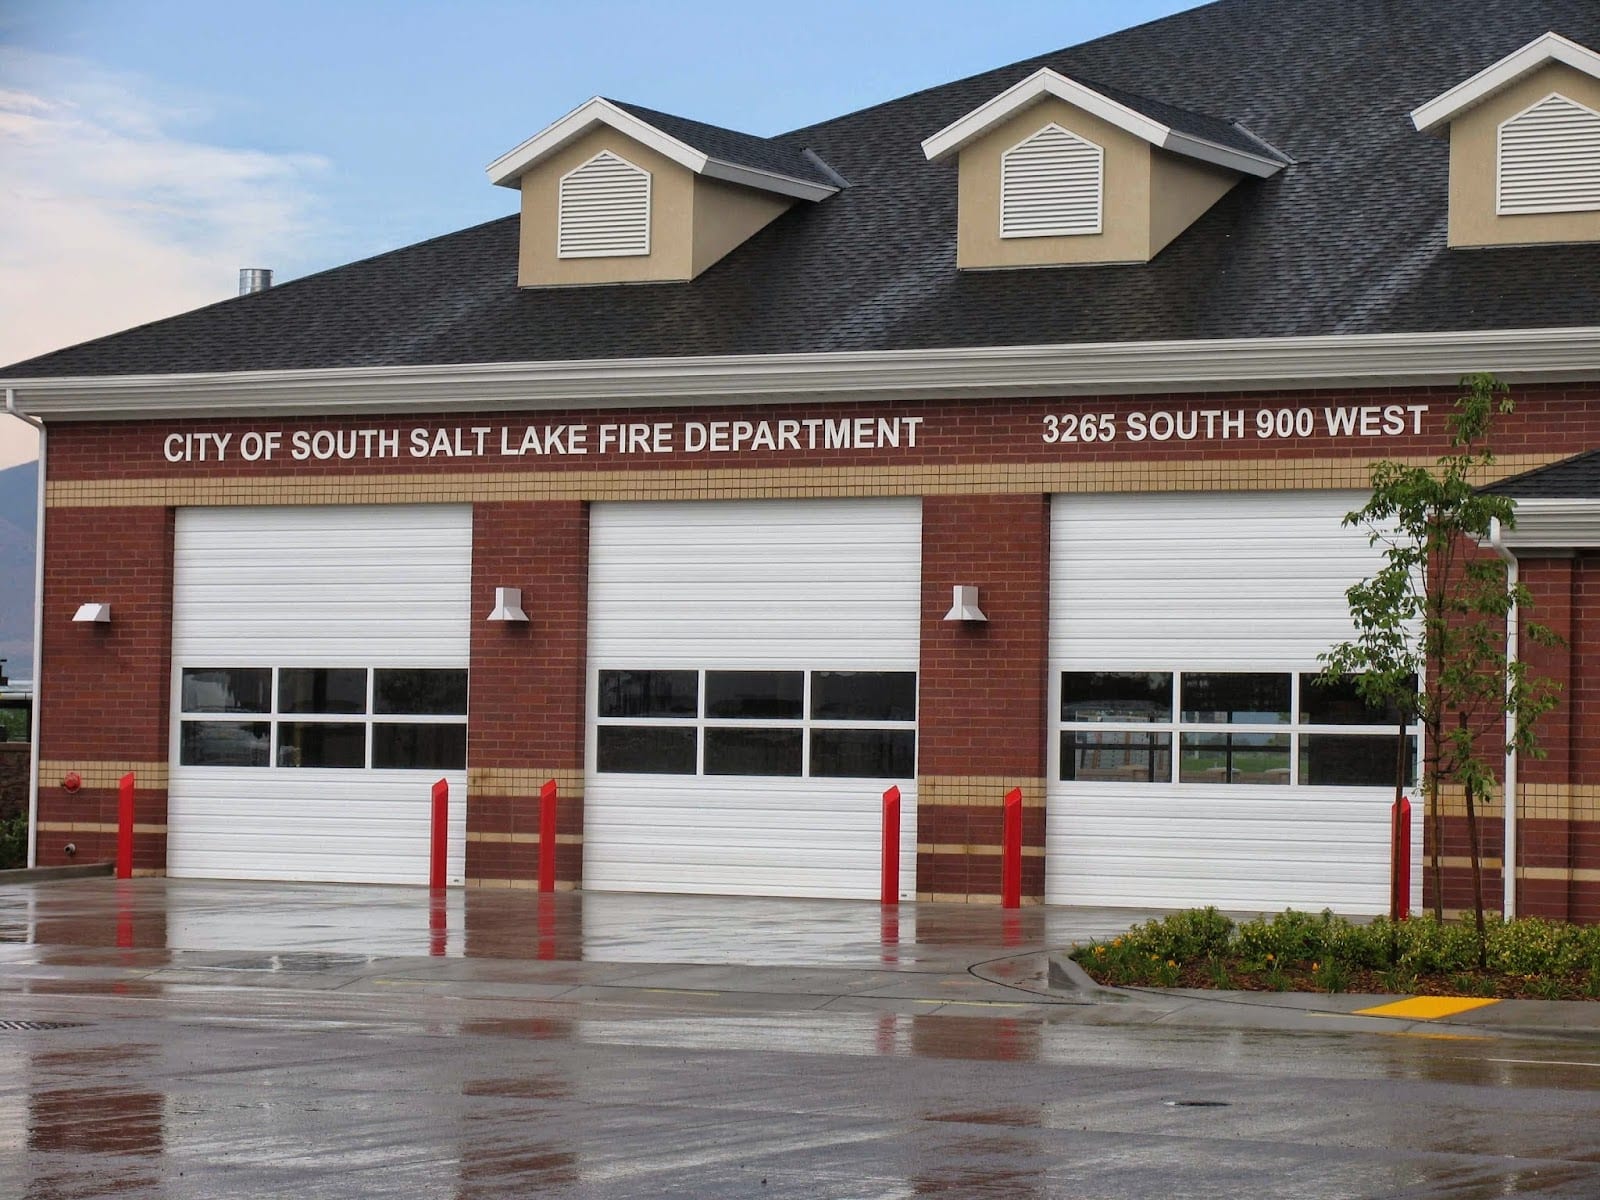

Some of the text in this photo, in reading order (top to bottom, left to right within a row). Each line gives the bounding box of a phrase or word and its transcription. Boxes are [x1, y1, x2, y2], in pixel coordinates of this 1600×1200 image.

[163, 416, 924, 462] CITY OF SOUTH SALT LAKE FIRE DEPARTMENT
[1042, 405, 1429, 443] 3265 SOUTH 900 WEST
